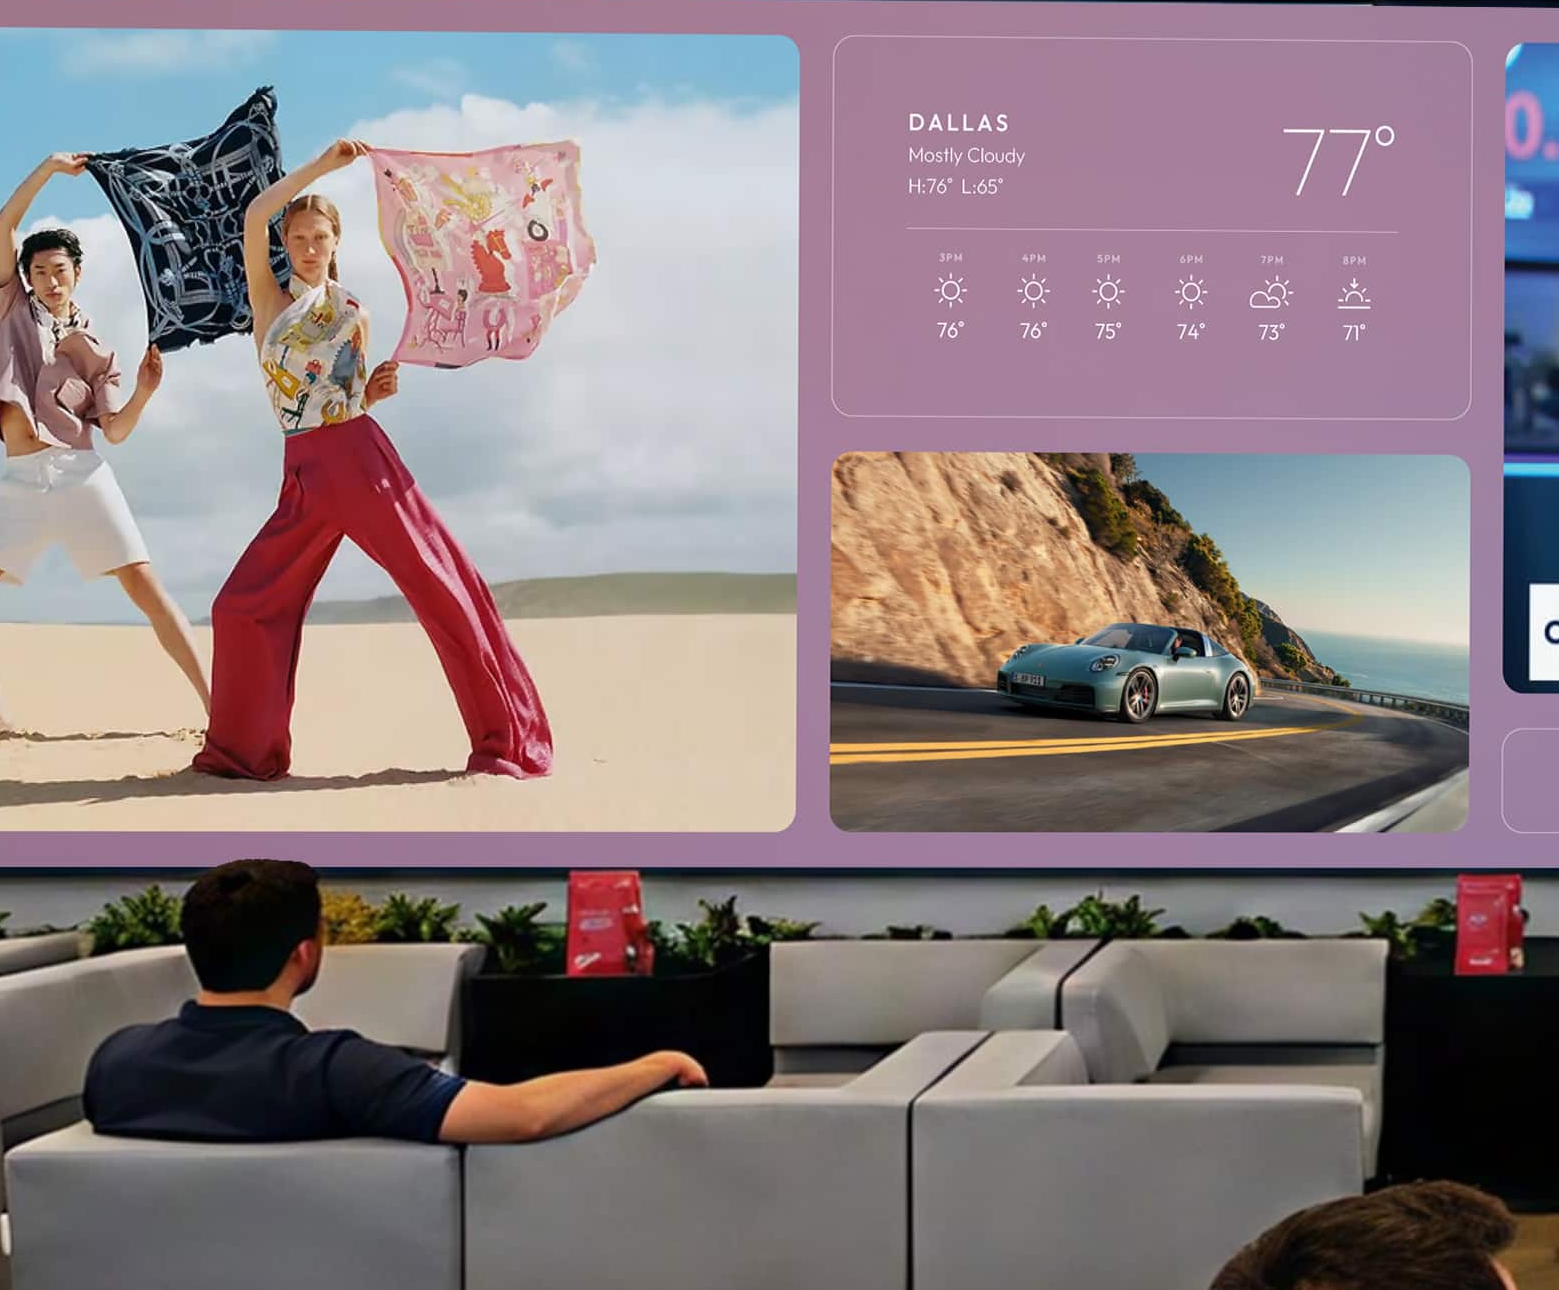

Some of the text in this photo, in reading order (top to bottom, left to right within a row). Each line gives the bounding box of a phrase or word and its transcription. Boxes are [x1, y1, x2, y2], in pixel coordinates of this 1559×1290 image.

[910, 114, 1007, 132] DALLAS
[909, 147, 1025, 167] Mostly Cloudy
[939, 253, 1366, 265] 3PM 4PM 5PM 6PM 7PM 8PM
